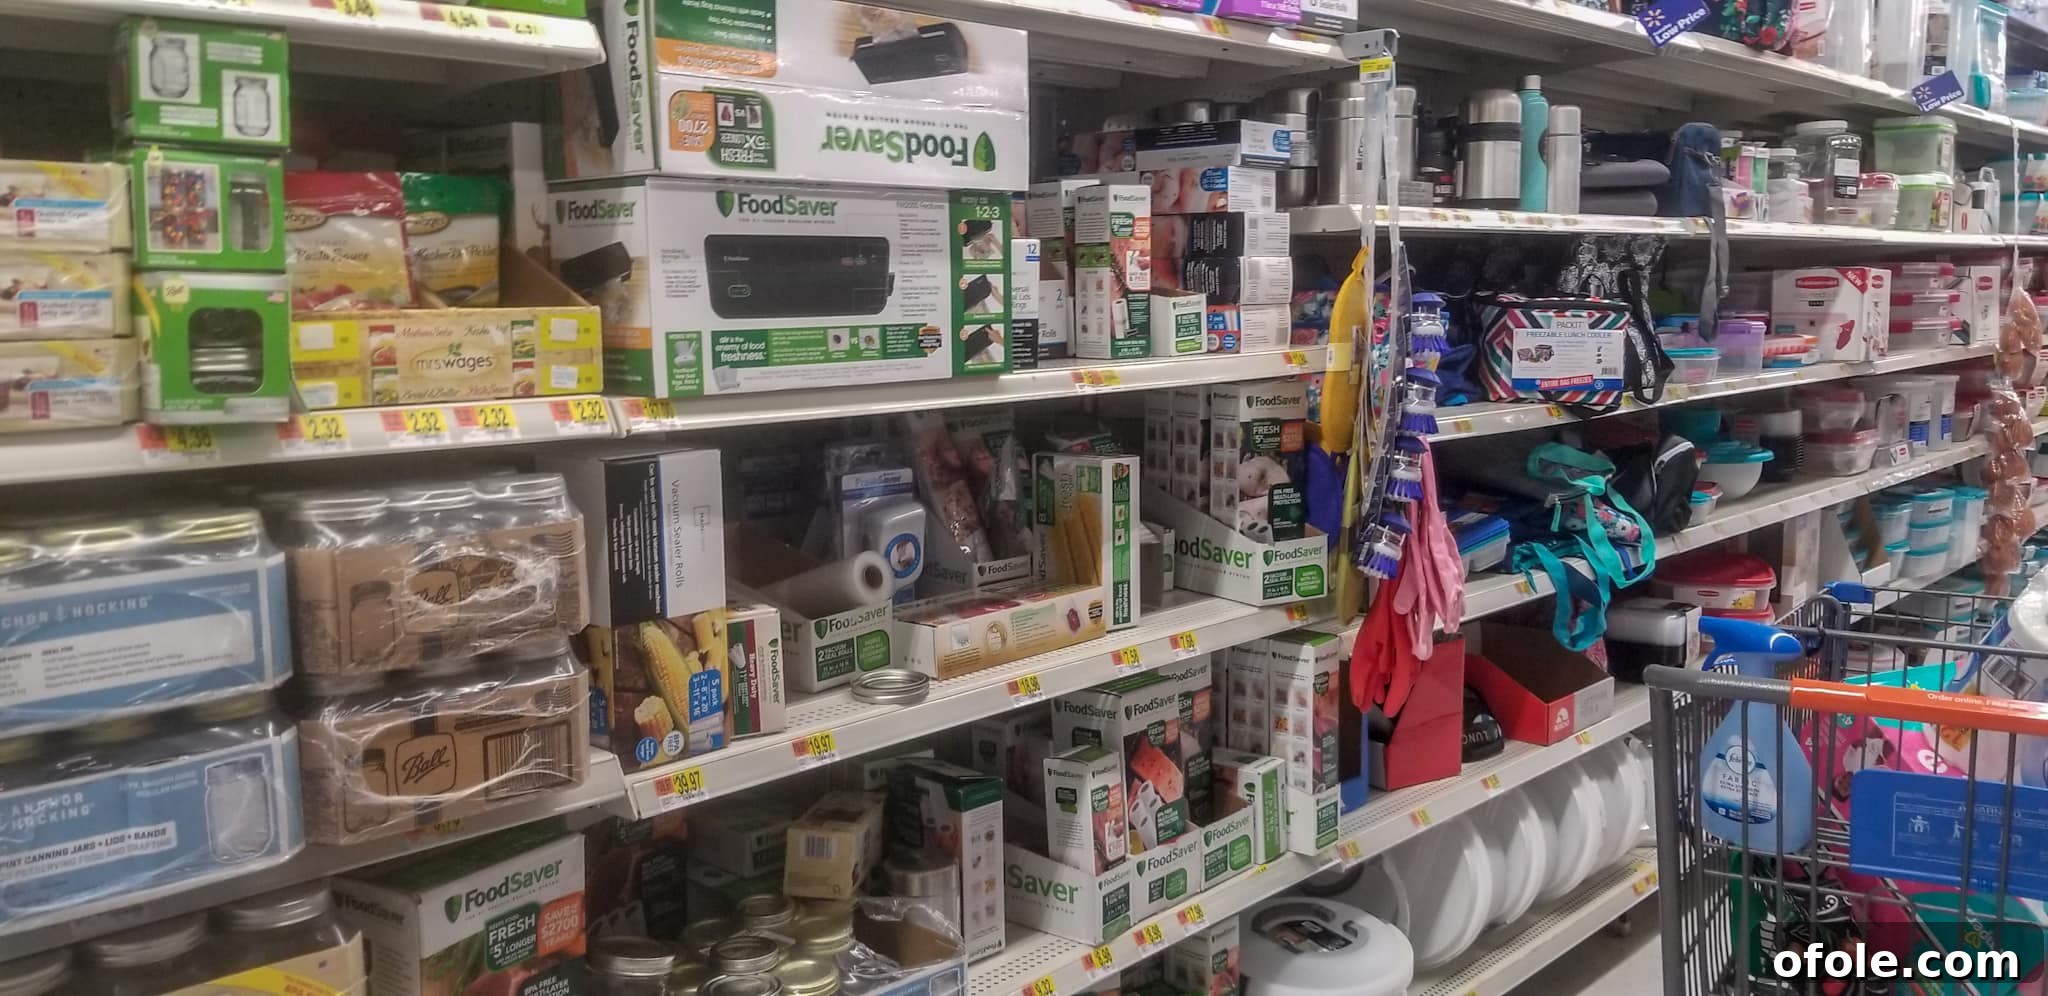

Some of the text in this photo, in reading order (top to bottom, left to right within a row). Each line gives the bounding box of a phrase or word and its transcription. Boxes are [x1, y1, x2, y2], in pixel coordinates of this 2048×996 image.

[1654, 8, 1706, 44] Low Price
[627, 20, 643, 154] FoodSaver
[1923, 90, 1962, 112] Low Price
[720, 148, 753, 162] FRESH
[822, 125, 968, 167] FoodSaver
[568, 200, 634, 221] FoodSaver
[738, 194, 838, 217] FoodSaver
[1026, 243, 1038, 254] 12
[1846, 271, 1864, 287] NEW
[1056, 289, 1062, 301] 2
[1542, 376, 1592, 388] ENTIRE BAG FREEZES
[575, 399, 605, 420] 2.32
[1255, 395, 1302, 406] FoodSaver
[307, 417, 343, 440] 2.32
[410, 412, 440, 432] 2.32
[479, 407, 510, 428] 2.32
[1253, 425, 1280, 435] FRESH
[671, 479, 685, 588] Vacuum Sealer Rolls
[1174, 536, 1252, 569] oodSaver
[1274, 547, 1323, 562] FoodSaver
[1264, 575, 1269, 585] 2
[2, 597, 149, 631] CHOR HOCKING
[818, 650, 825, 662] 2
[748, 652, 758, 699] Heavy Duty
[770, 649, 781, 704] FoodSaver
[711, 688, 719, 707] pack
[1134, 694, 1177, 717] FoodSaver
[1927, 693, 1952, 702] Order
[1064, 700, 1117, 720] FoodSaver
[403, 745, 450, 785] Ball
[1722, 773, 1757, 788] FABC
[12, 792, 83, 817] ANCHOR
[12, 803, 91, 831] HOCKING
[1213, 815, 1250, 841] FoodSaver
[25, 848, 68, 866] CANNING
[71, 840, 96, 855] JARS
[104, 836, 125, 848] LIDS
[134, 826, 168, 840] BANDS
[1148, 841, 1198, 871] FoodSaver
[465, 859, 563, 913] FoodSaver
[1007, 863, 1079, 905] Saver
[545, 903, 578, 921] SAVES
[488, 912, 537, 946] FRESH
[542, 915, 579, 939] $2700
[506, 934, 537, 953] LONGER
[540, 975, 557, 990] FREE
